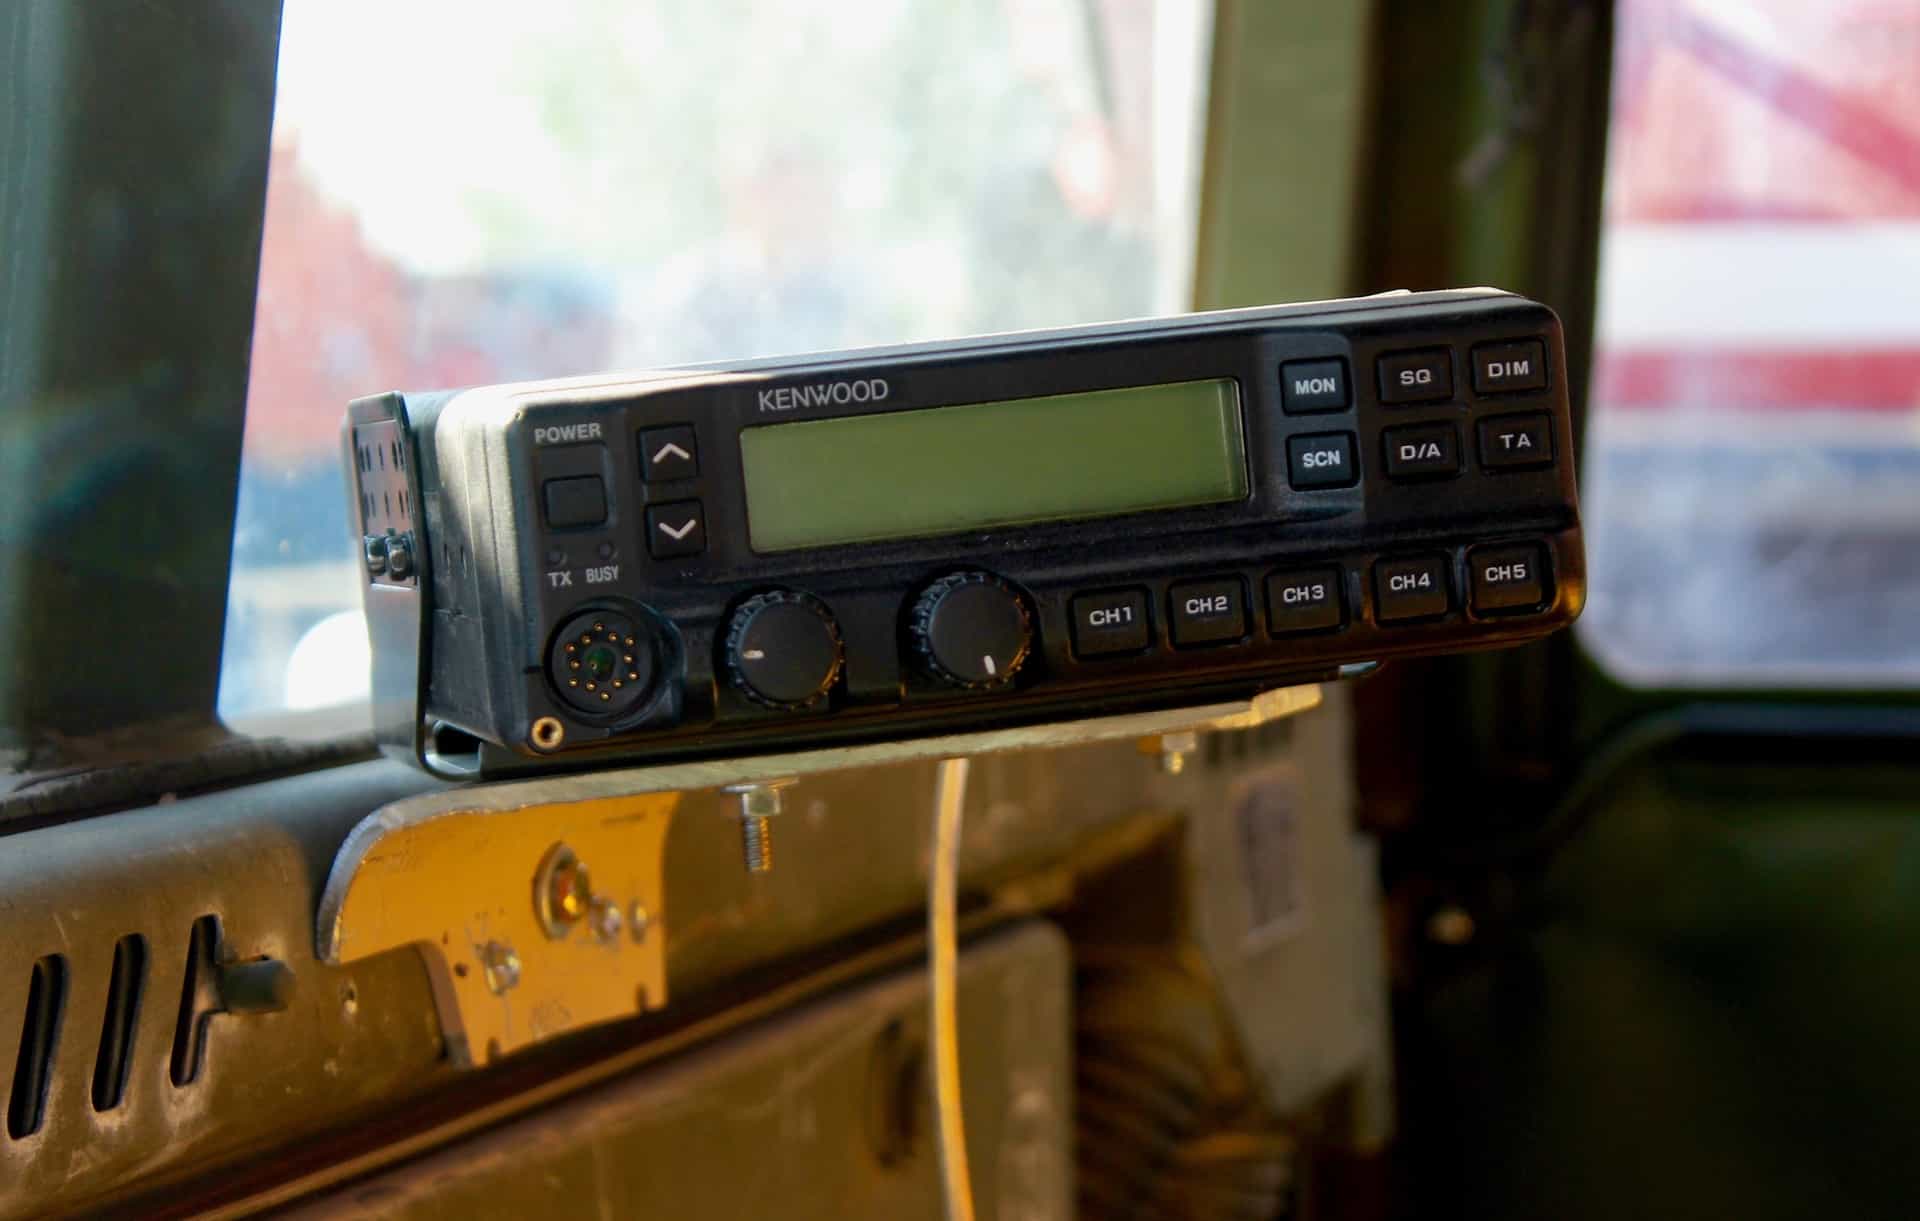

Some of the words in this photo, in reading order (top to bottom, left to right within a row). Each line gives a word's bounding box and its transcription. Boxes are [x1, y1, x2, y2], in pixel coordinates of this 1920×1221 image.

[1399, 368, 1432, 385] SQ
[1487, 360, 1530, 378] DIM
[758, 378, 889, 412] KENWOOD
[1295, 377, 1336, 395] MON
[534, 422, 602, 444] POWER
[1500, 432, 1532, 449] TA
[1302, 449, 1341, 469] SCN
[1399, 442, 1441, 460] D/A
[547, 571, 572, 587] TX
[585, 565, 619, 585] BUSY
[1389, 572, 1431, 591] CH4
[1485, 563, 1526, 582] CH5
[1283, 584, 1325, 603] CH3
[1185, 595, 1229, 615] CH2
[1089, 605, 1134, 626] CH1
